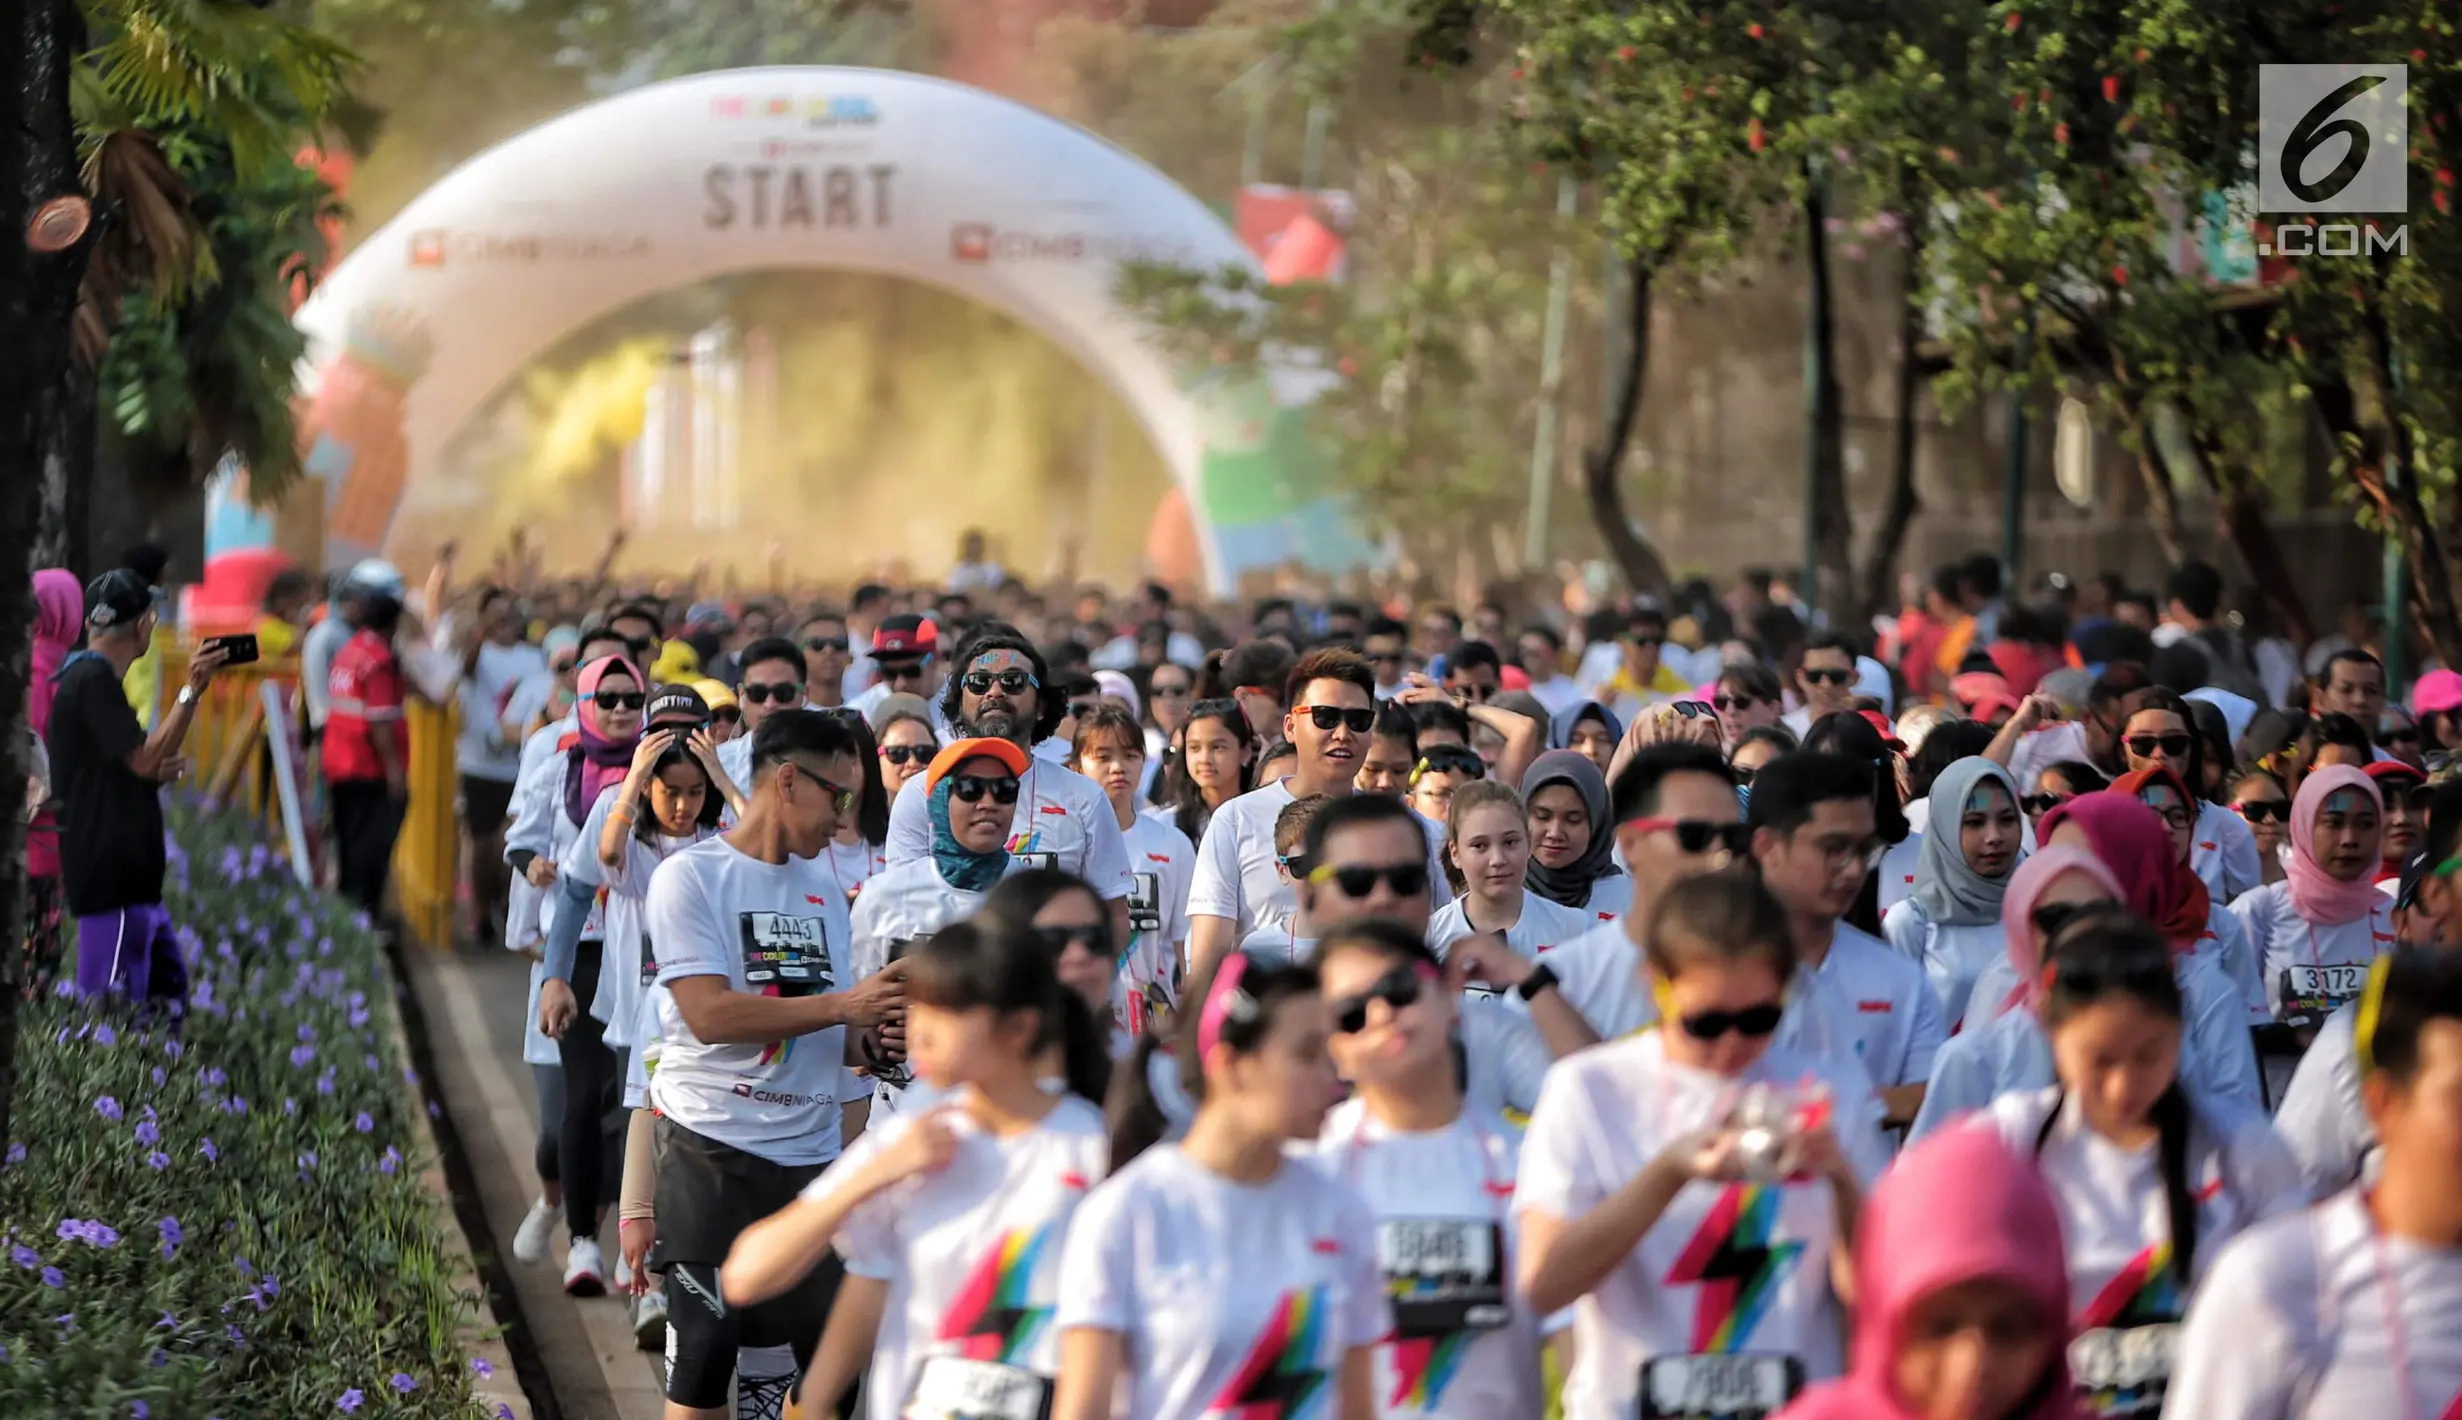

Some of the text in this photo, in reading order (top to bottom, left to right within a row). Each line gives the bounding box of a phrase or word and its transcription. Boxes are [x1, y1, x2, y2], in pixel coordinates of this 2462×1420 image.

[702, 160, 900, 231] START
[769, 914, 812, 940] 4443
[2305, 968, 2358, 991] 3172
[753, 1089, 834, 1107] CIMBNIAGA
